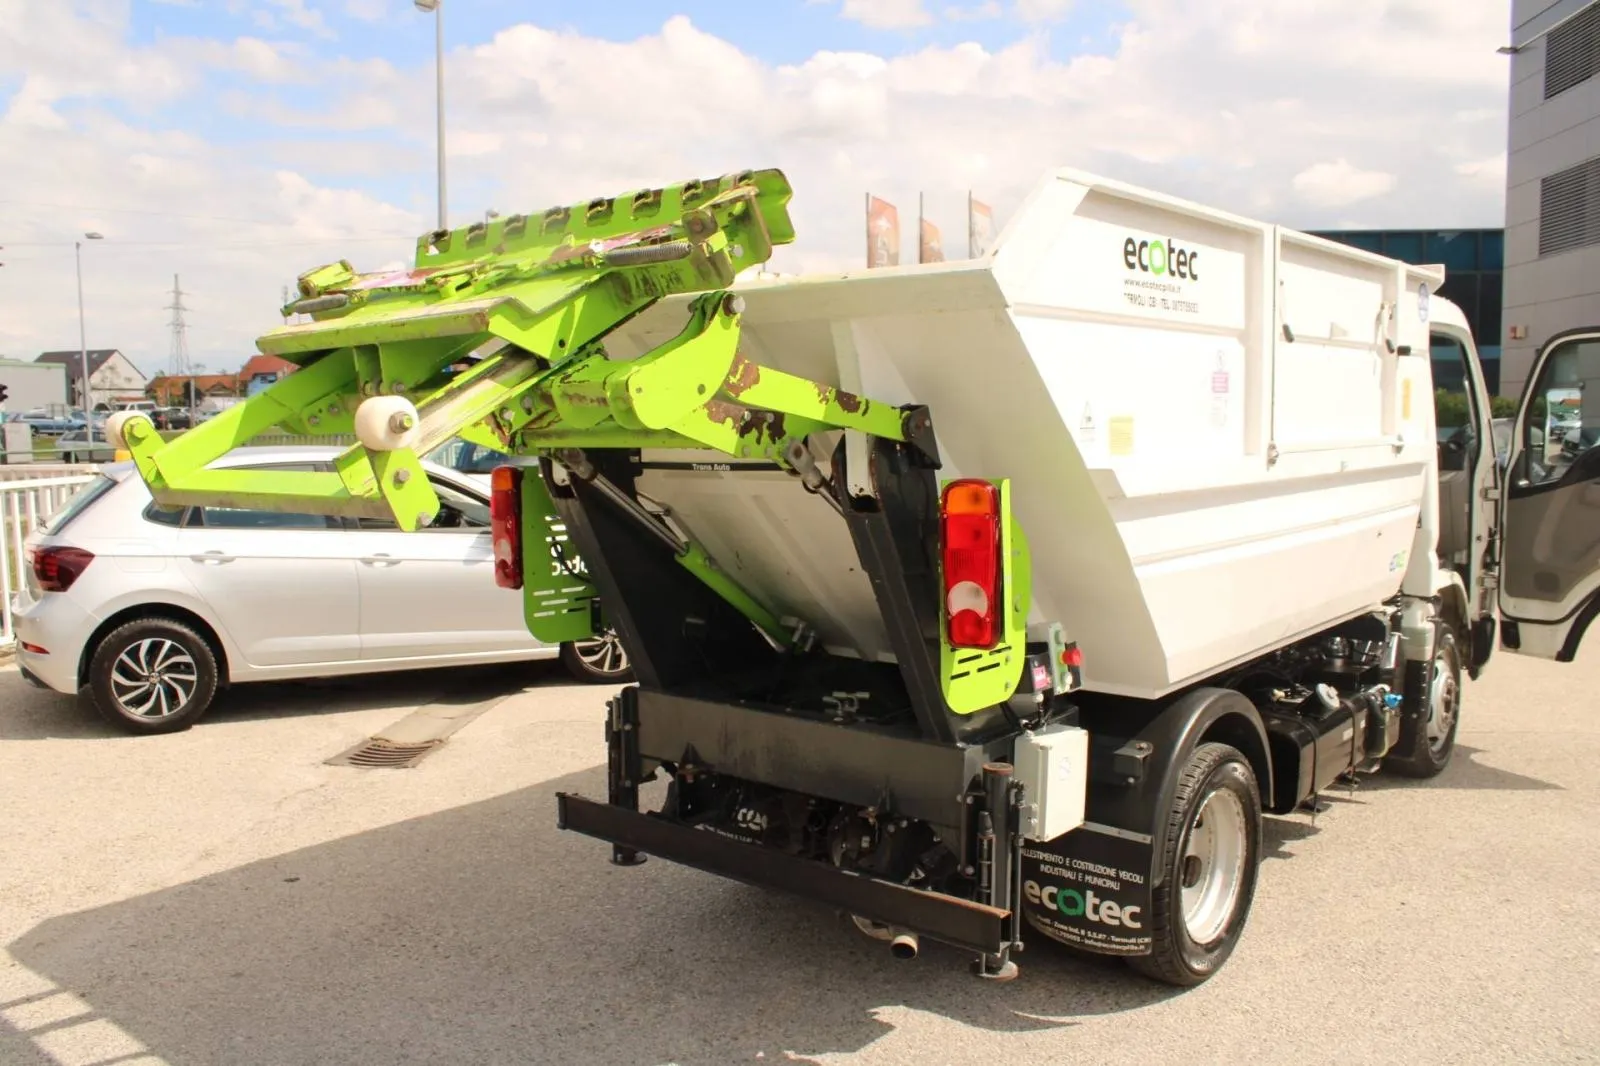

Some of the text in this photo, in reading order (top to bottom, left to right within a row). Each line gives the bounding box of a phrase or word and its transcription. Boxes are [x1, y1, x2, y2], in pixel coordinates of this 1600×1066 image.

[1124, 237, 1198, 281] ecotec
[692, 463, 731, 471] Trans Auto
[1040, 864, 1120, 891] INDUSTRIALI E MUNICIPALI
[1065, 857, 1070, 866] E
[1072, 859, 1117, 878] COSTRUZIONE
[1119, 869, 1144, 884] VEICOLI
[1023, 880, 1142, 928] ecotec
